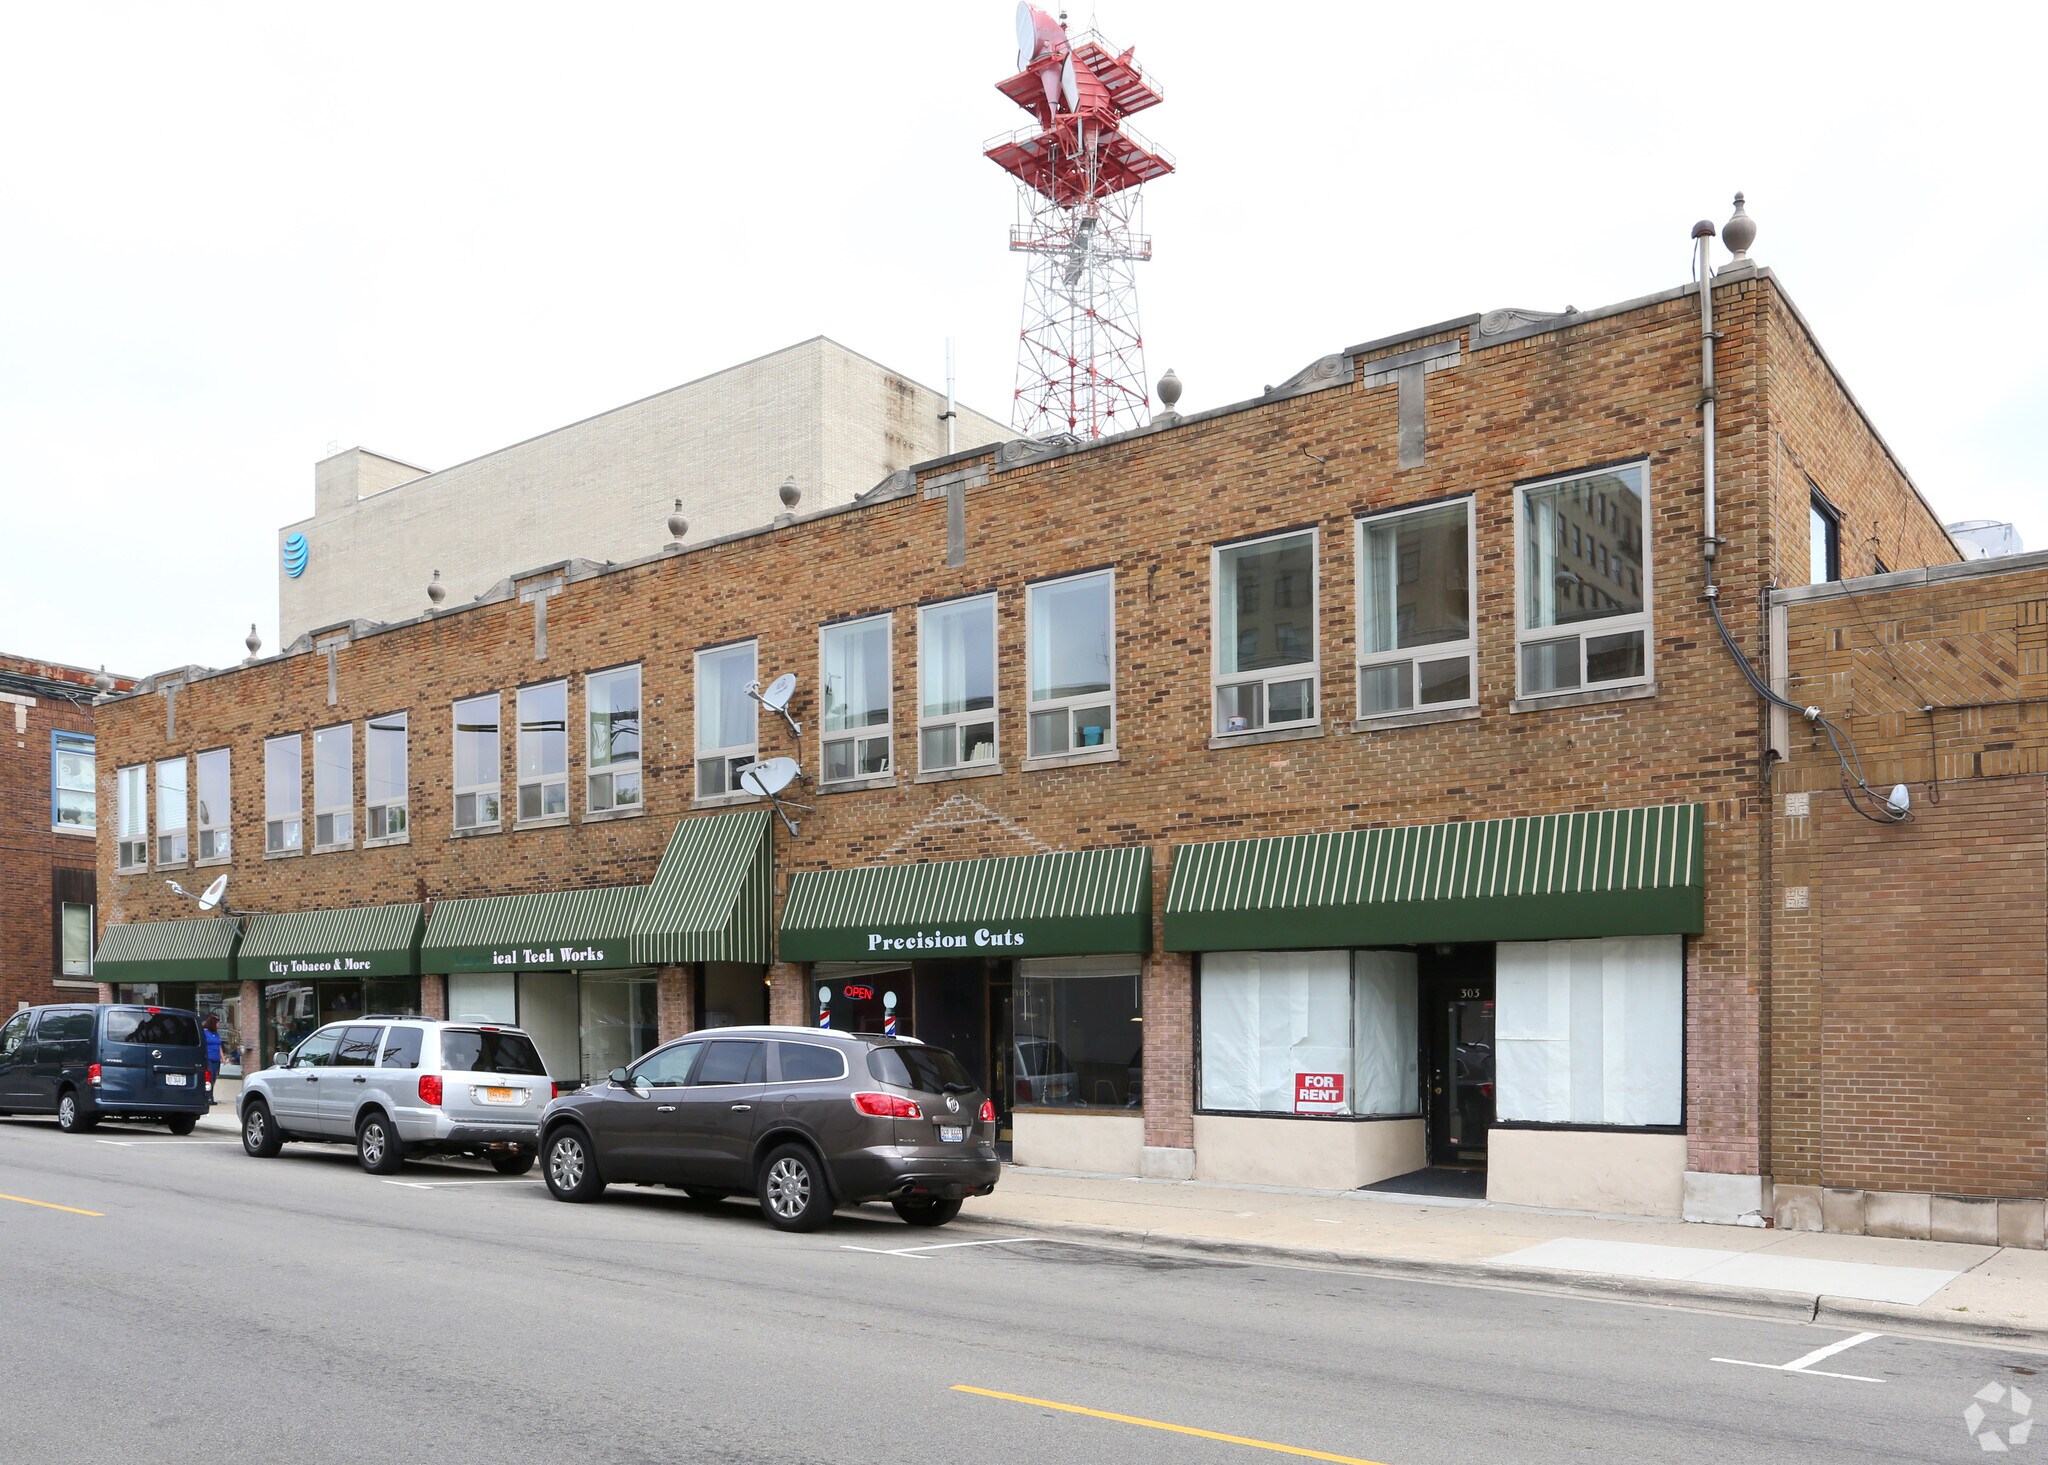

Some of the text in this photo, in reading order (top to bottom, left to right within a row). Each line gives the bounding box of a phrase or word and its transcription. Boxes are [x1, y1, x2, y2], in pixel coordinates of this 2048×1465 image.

[867, 928, 1025, 951] Precision Cuts
[492, 950, 517, 965] ical
[522, 948, 555, 964] Tech
[559, 946, 604, 963] Works
[269, 957, 371, 976] City Tobacco & More
[844, 985, 873, 1000] OPEN
[1460, 988, 1480, 999] 303
[1304, 1075, 1335, 1088] FOR
[1299, 1088, 1340, 1101] RENT
